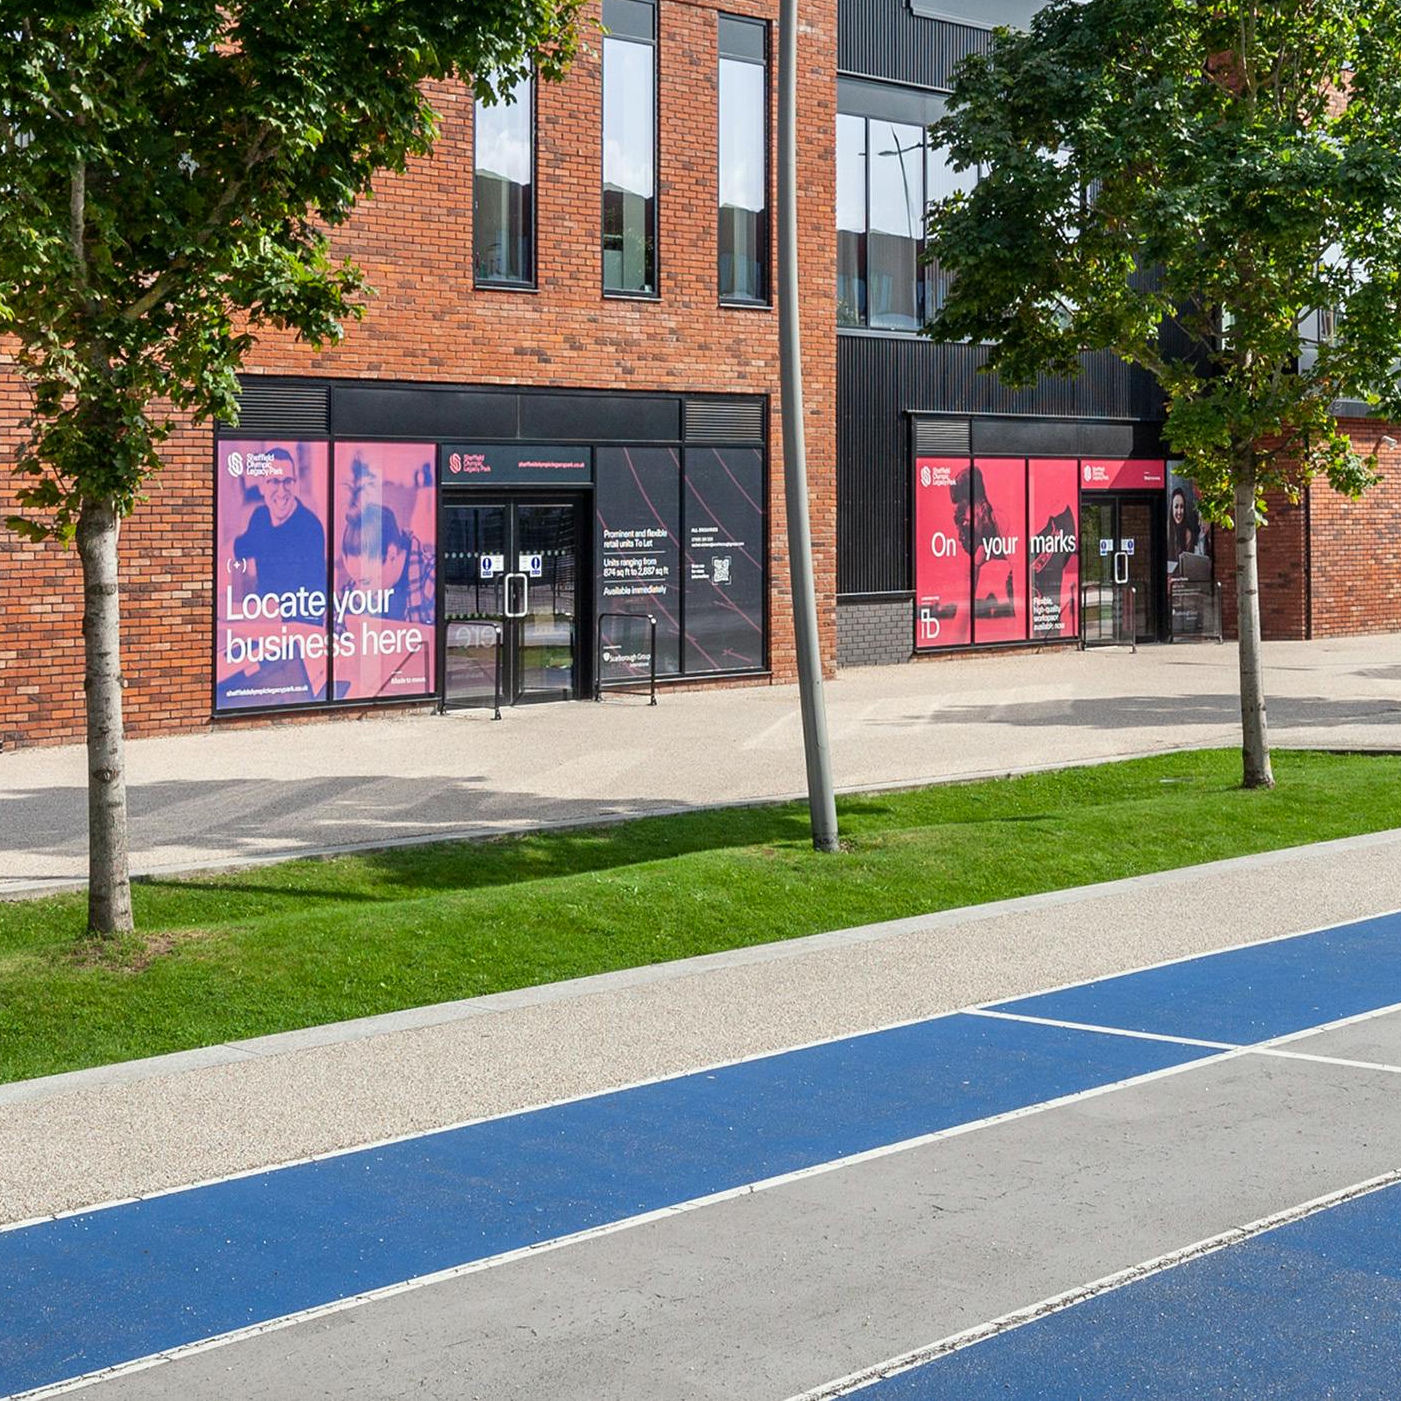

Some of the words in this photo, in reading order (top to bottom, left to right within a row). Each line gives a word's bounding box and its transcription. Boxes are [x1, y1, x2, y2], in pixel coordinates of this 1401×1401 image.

[246, 453, 275, 461] Sheffield
[246, 461, 272, 469] Olympic
[246, 467, 269, 476] Legacy
[269, 467, 283, 475] Park
[603, 529, 634, 538] Prominent
[635, 529, 646, 537] and
[619, 539, 634, 548] units
[634, 539, 643, 547] To
[643, 539, 653, 547] Let
[931, 531, 957, 558] On
[982, 536, 1018, 561] your
[1030, 529, 1076, 554] marks
[603, 558, 619, 567] Units
[620, 558, 642, 568] ranging
[616, 569, 624, 578] sq
[624, 567, 630, 576] ft
[630, 568, 637, 576] to
[655, 568, 663, 577] sq
[663, 566, 669, 575] ft
[603, 586, 631, 596] Available
[631, 585, 667, 595] immediately
[226, 585, 326, 621] Locate
[333, 588, 394, 623] your
[226, 625, 355, 664] business
[361, 621, 423, 656] here
